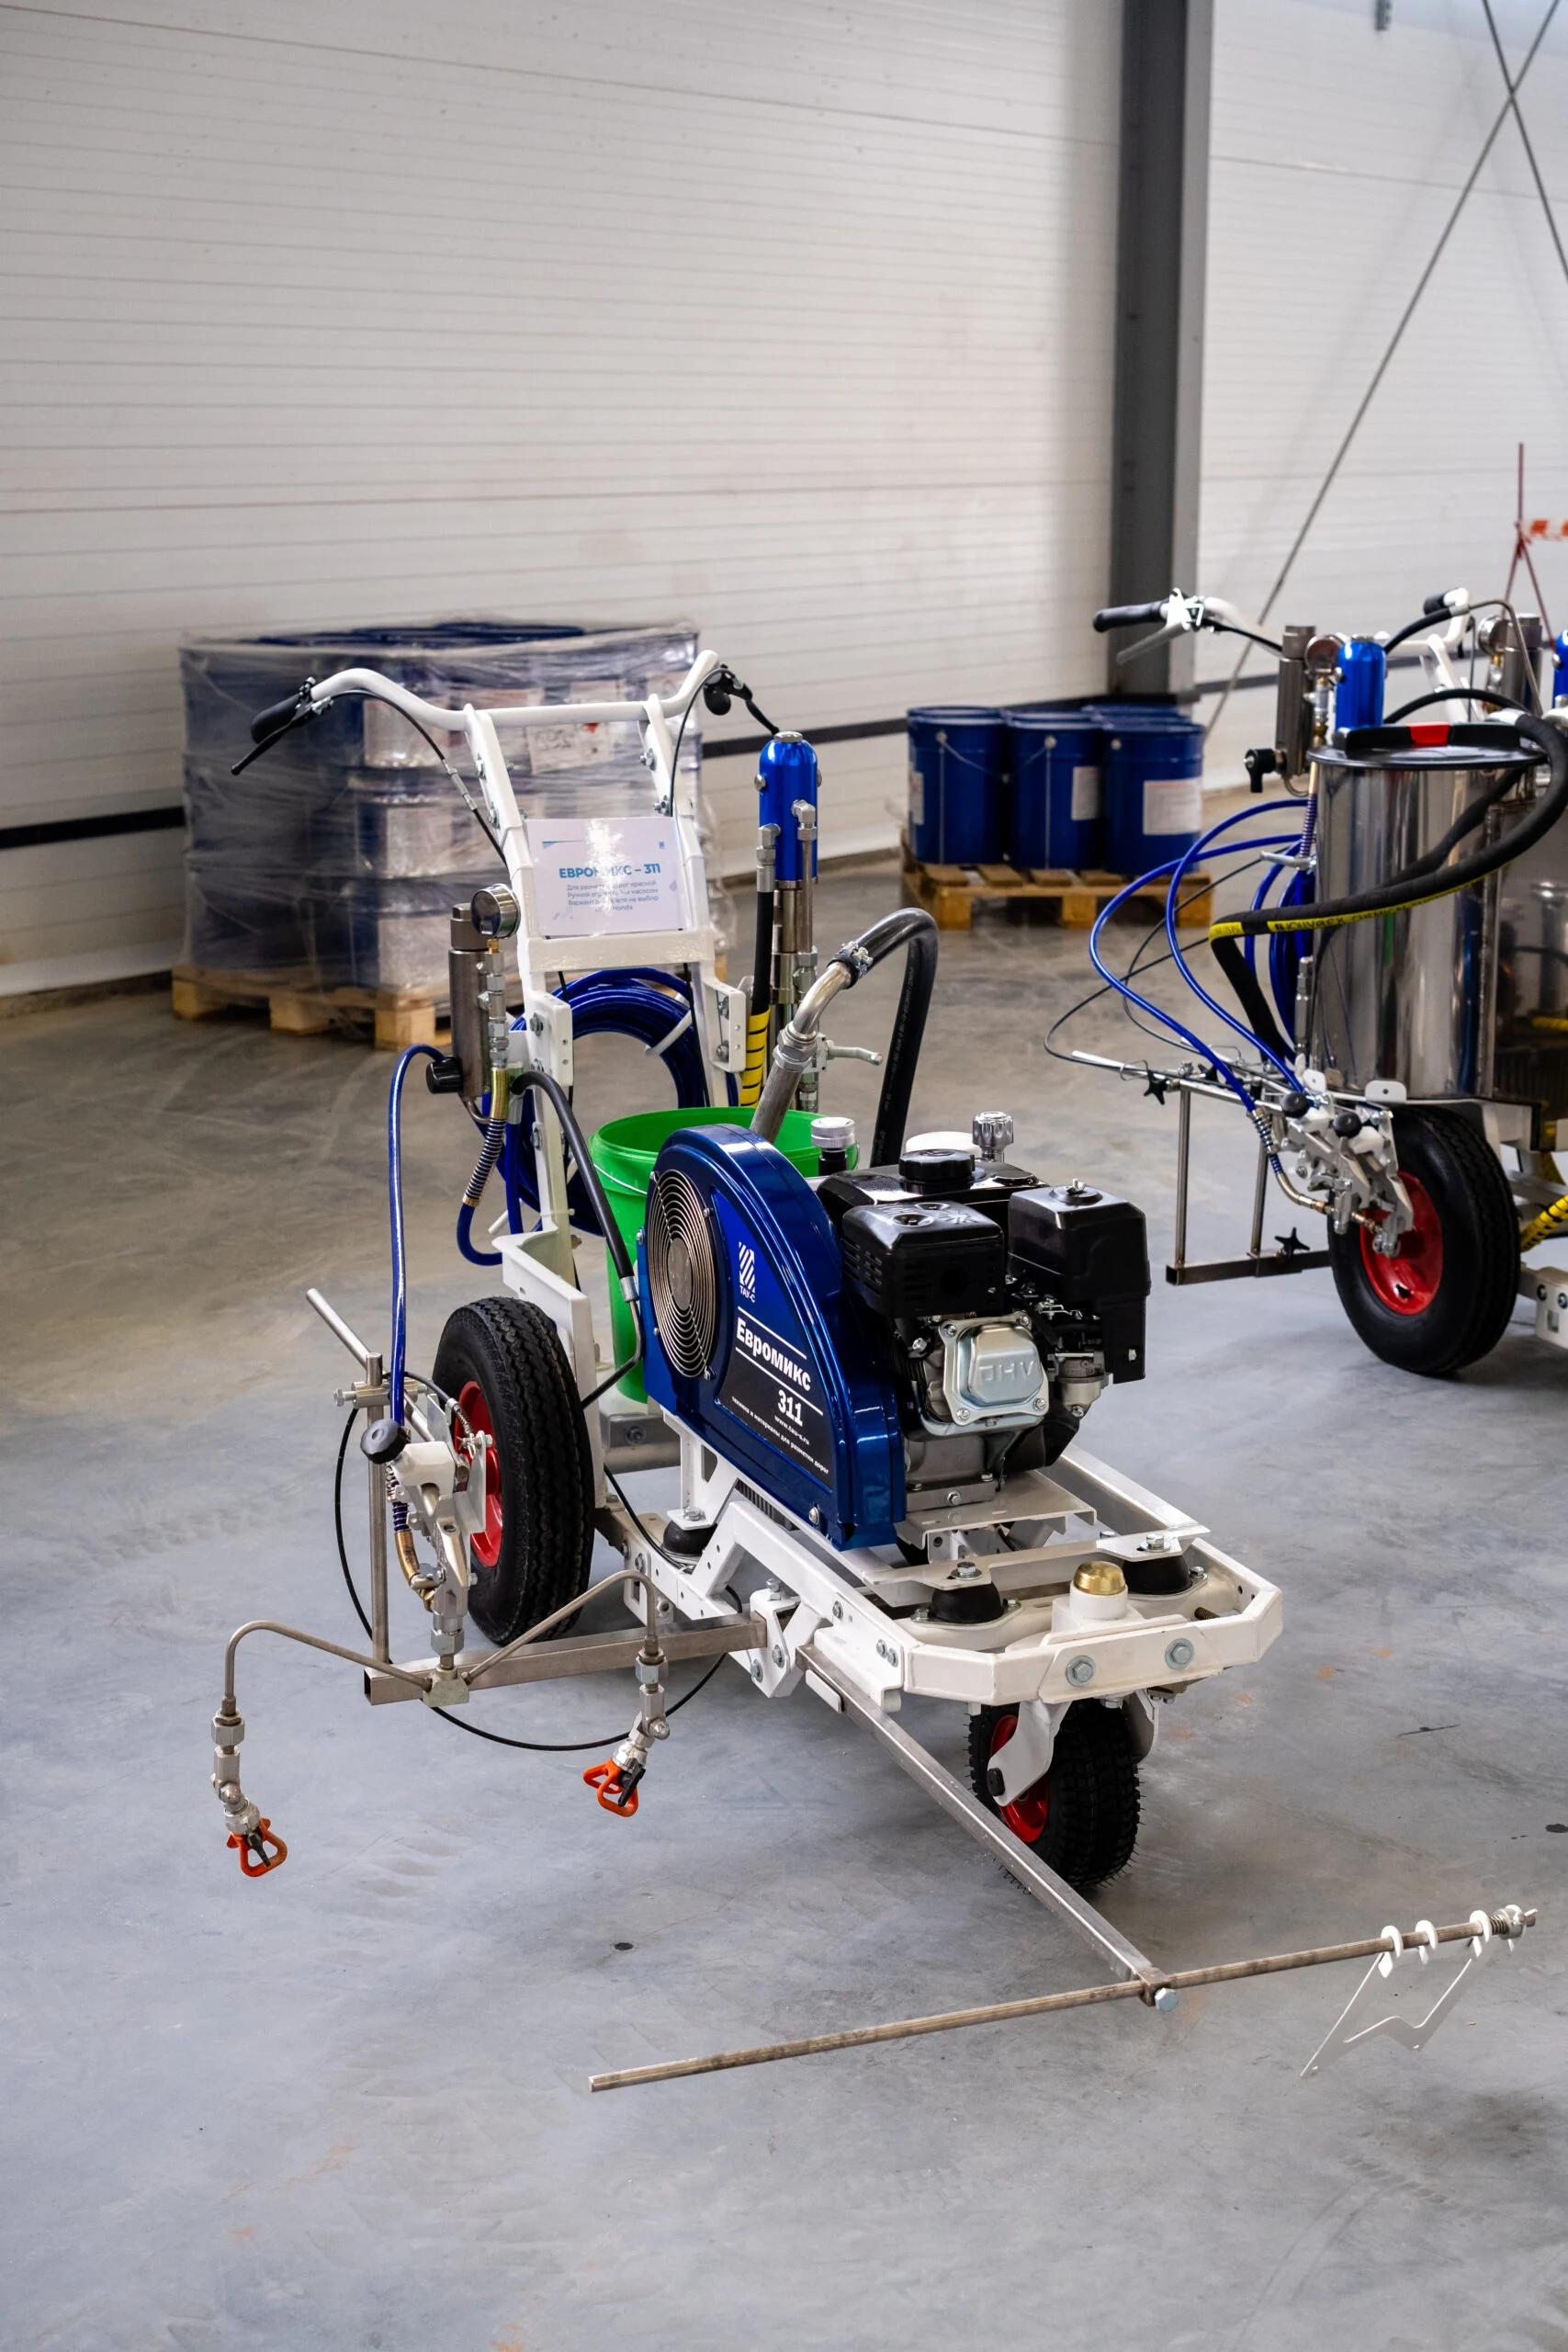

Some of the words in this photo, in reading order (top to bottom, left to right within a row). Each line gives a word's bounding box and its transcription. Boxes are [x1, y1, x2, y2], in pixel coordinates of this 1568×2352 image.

[643, 863, 660, 874] 311
[739, 1284, 756, 1304] ТАУ-С
[737, 1317, 812, 1392] Евромикс
[777, 1389, 804, 1427] 311
[754, 1414, 781, 1437] материалы
[780, 1434, 791, 1446] для
[790, 1442, 814, 1464] разметки
[814, 1460, 829, 1476] дорог
